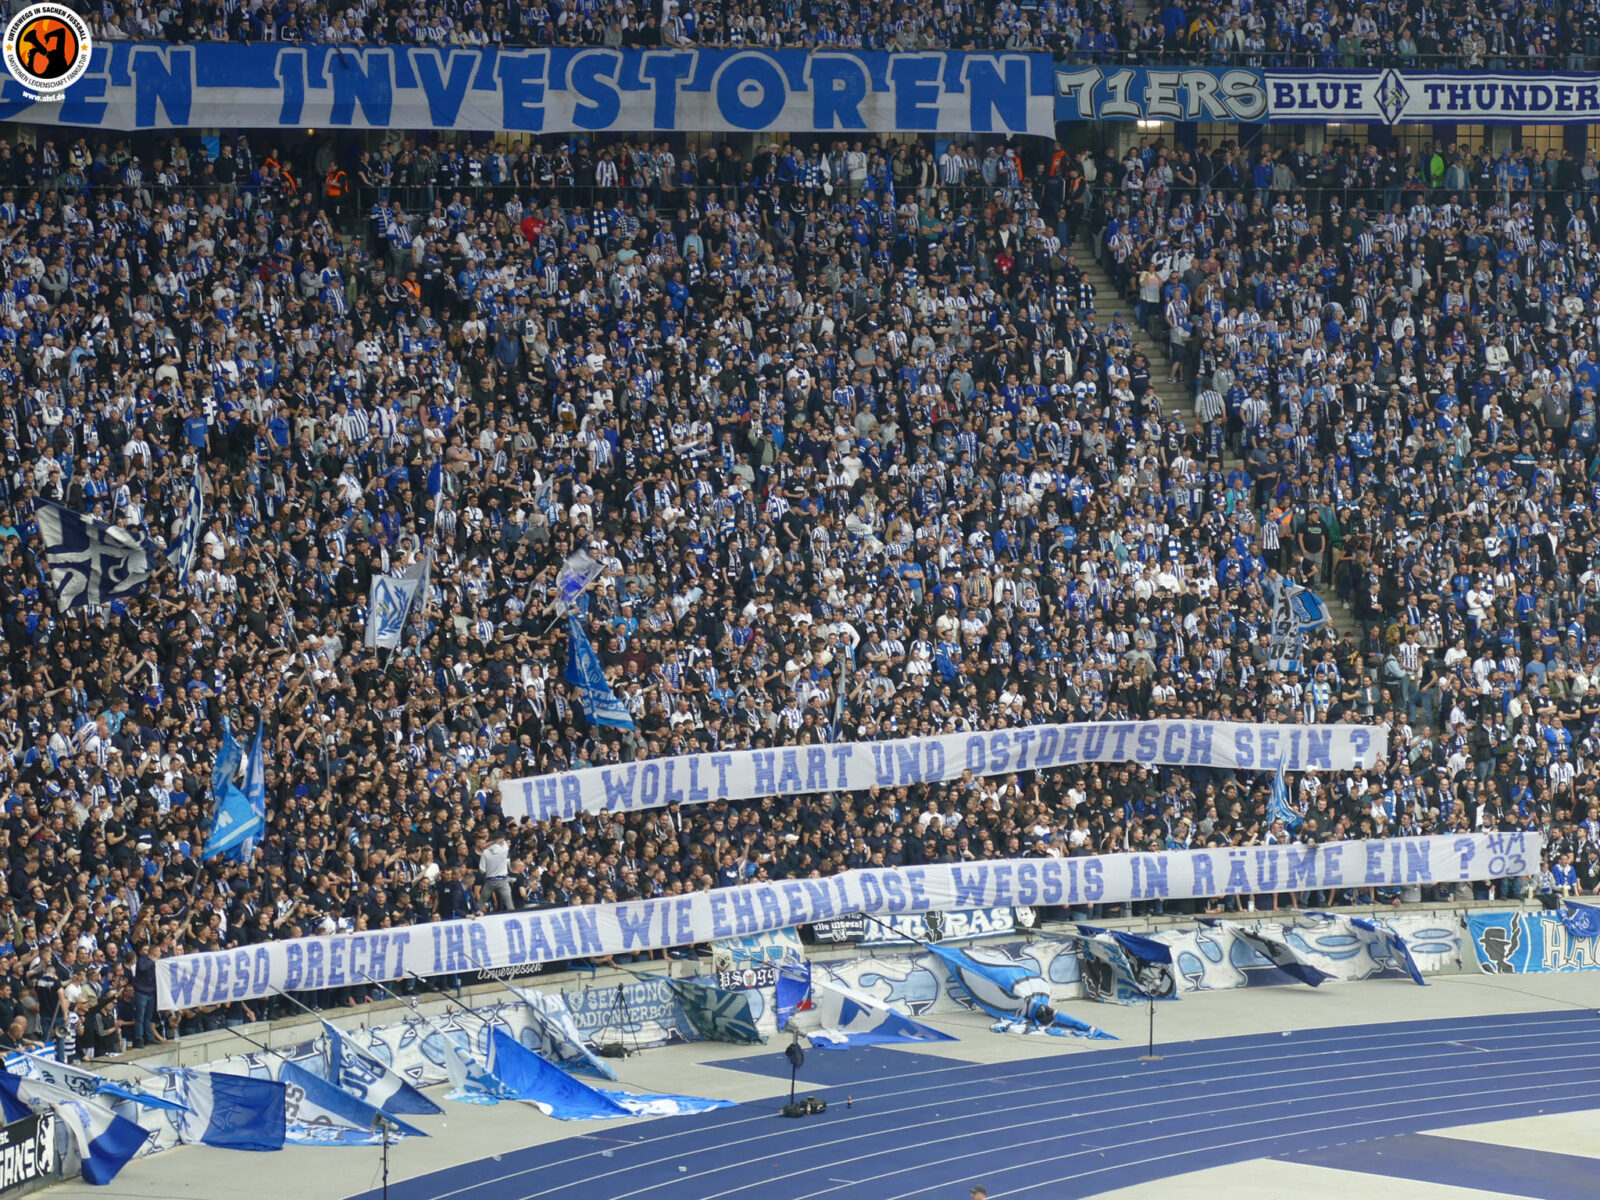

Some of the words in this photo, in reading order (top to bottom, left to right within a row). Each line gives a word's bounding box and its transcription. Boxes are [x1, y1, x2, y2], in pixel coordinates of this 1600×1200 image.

[278, 47, 1031, 135] INVESTOREN
[1056, 69, 1268, 121] 71ERS
[1273, 82, 1363, 109] BLUE
[1424, 84, 1600, 111] THUNDER
[523, 776, 582, 824] IHR
[601, 755, 732, 811] WOLLT
[752, 746, 852, 794] HART
[872, 741, 945, 785] UND
[966, 724, 1213, 775] OSTDEUTSCH
[1236, 728, 1332, 770] SEIN
[1486, 833, 1526, 855] HM
[1488, 854, 1527, 876] 03
[169, 948, 270, 1006] WIESO
[284, 933, 410, 990] BRECHT
[432, 923, 492, 973] IHR
[504, 910, 603, 964] DANN
[615, 900, 695, 949] WIE
[711, 870, 931, 939] EHRENLOSE
[951, 858, 1104, 907] WESSIS
[1130, 856, 1169, 898] IN
[1192, 846, 1343, 894] RÄUME
[1366, 840, 1432, 884] EIN
[1454, 838, 1476, 879] ?
[586, 982, 658, 1010] SEKTION
[573, 1002, 674, 1028] TADIONVERBOT
